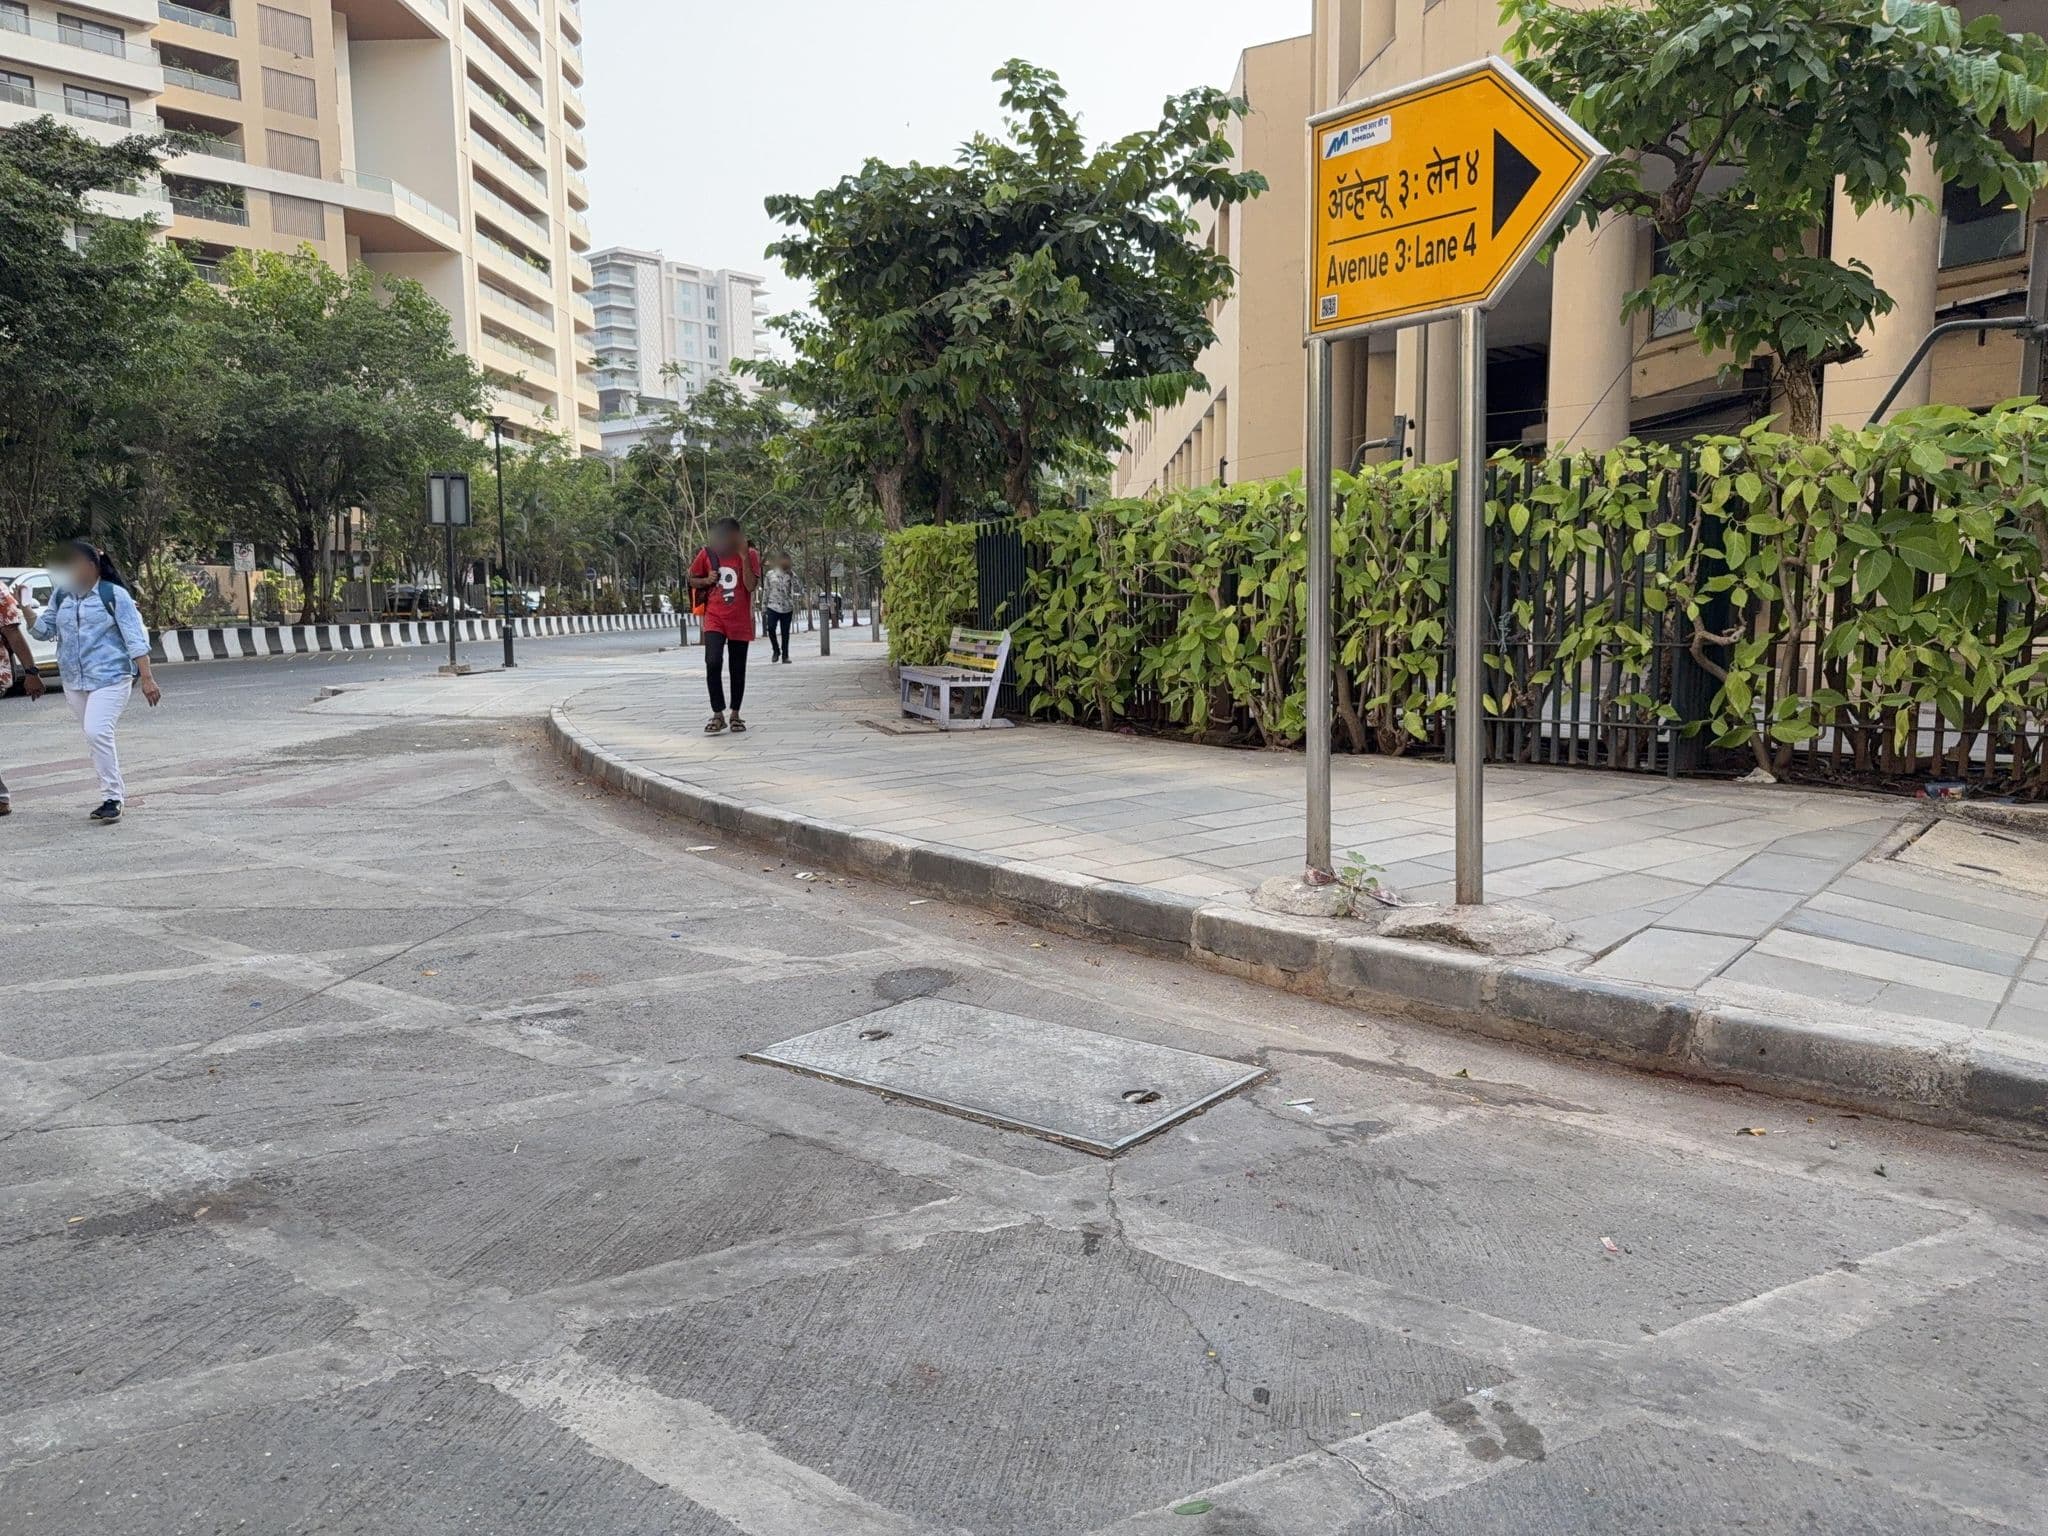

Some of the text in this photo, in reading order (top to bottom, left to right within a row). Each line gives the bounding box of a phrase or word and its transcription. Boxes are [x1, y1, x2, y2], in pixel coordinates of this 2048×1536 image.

[1351, 131, 1376, 144] MMRDA
[1425, 146, 1461, 196] लेन
[1466, 148, 1480, 186] ४
[1326, 251, 1389, 288] Avenue
[1415, 234, 1458, 269] Lane
[1463, 221, 1477, 257] 4
